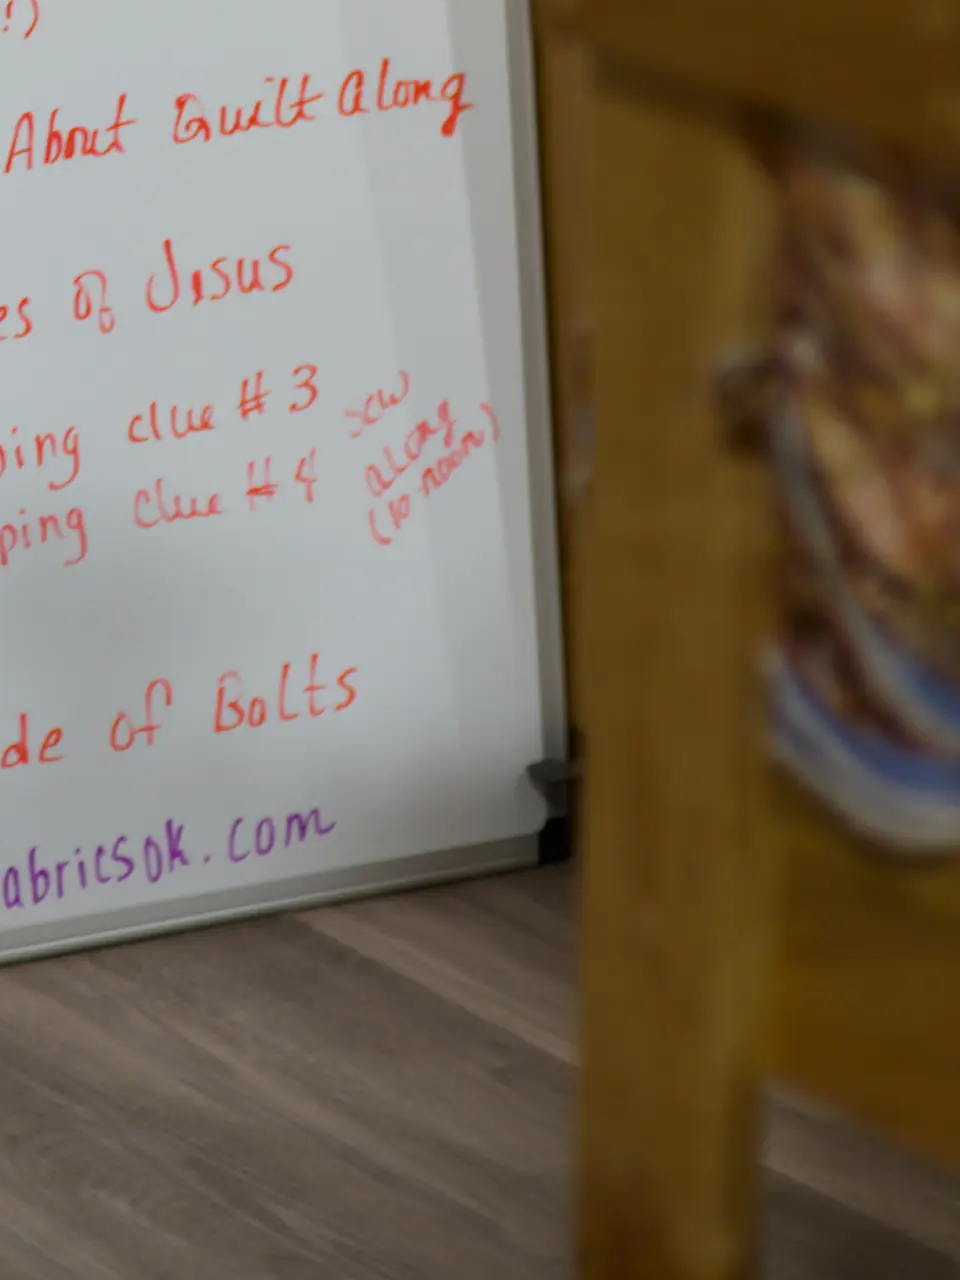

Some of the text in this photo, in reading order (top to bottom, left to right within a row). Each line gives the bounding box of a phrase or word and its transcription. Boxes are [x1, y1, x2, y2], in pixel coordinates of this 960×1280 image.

[3, 92, 139, 174] About
[171, 72, 325, 145] Quilt
[73, 269, 116, 334] of
[108, 677, 173, 753] of
[212, 652, 359, 733] Bolts
